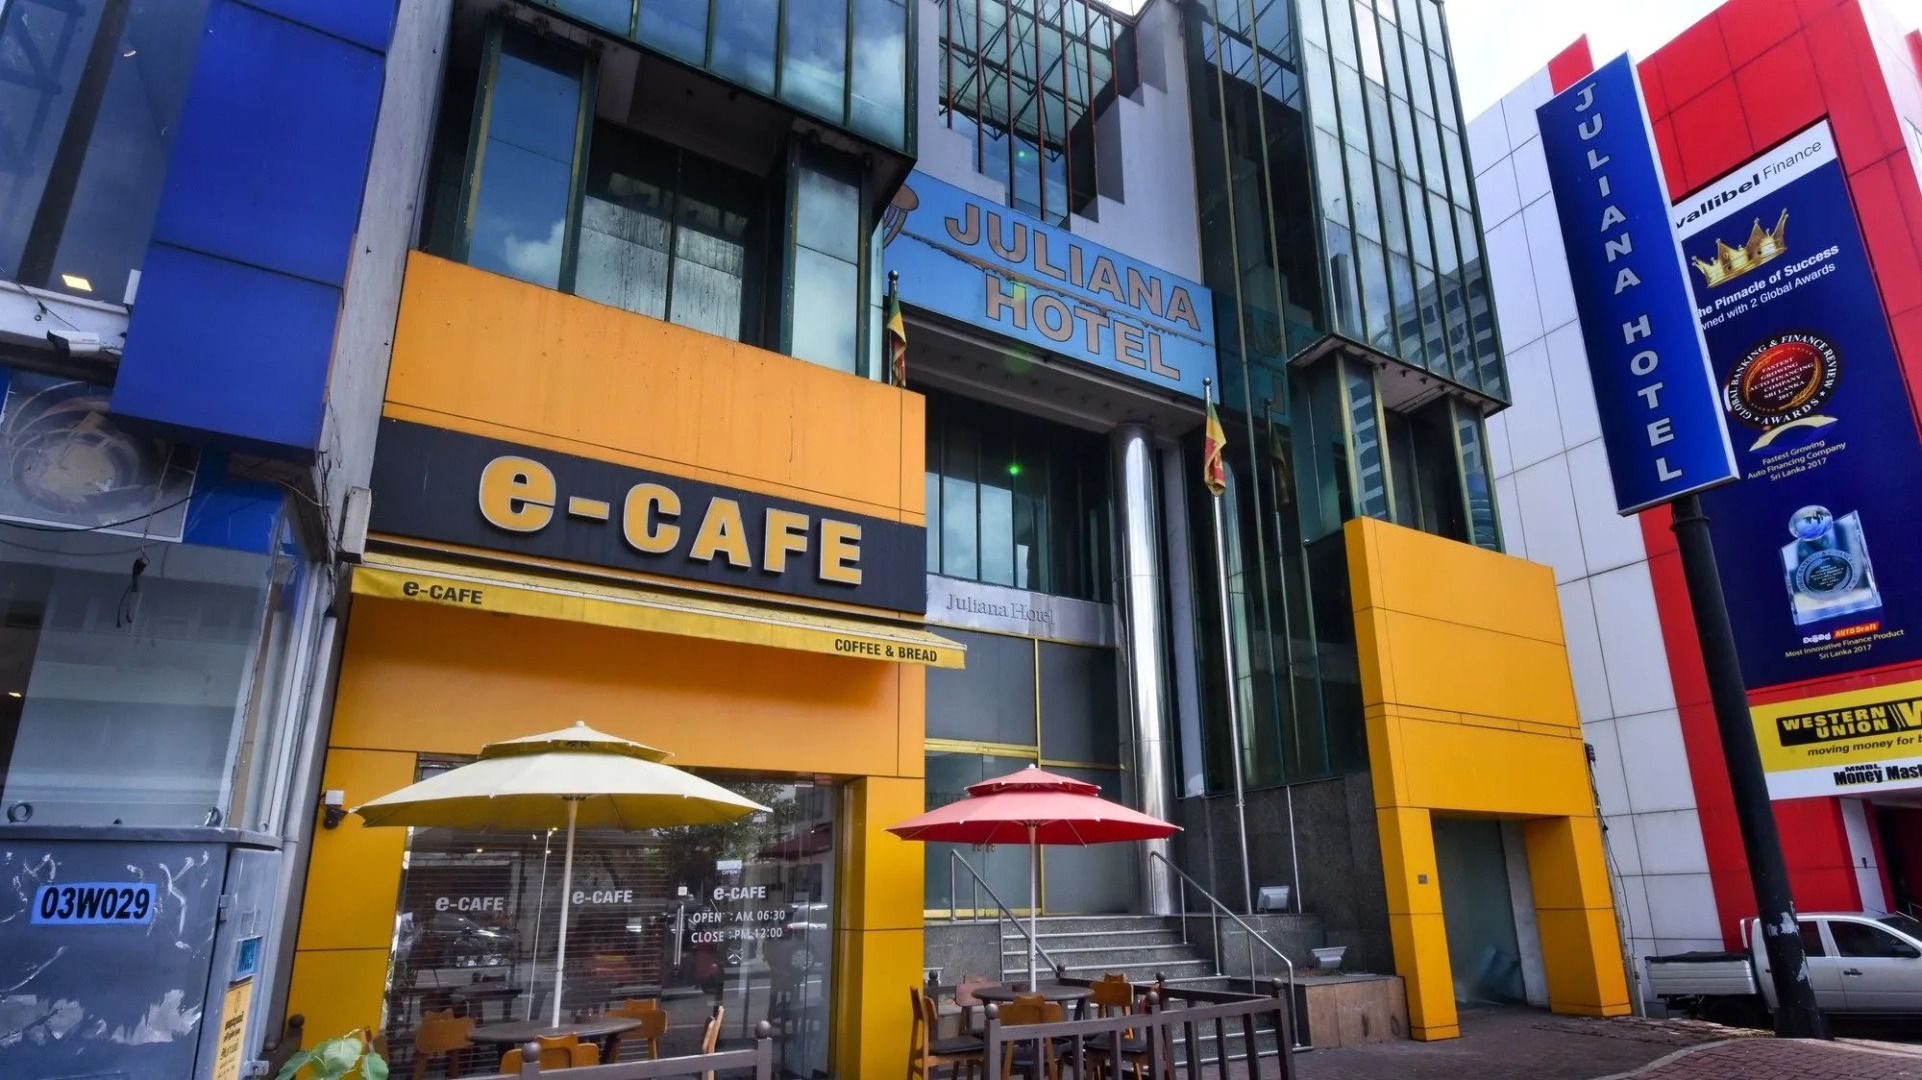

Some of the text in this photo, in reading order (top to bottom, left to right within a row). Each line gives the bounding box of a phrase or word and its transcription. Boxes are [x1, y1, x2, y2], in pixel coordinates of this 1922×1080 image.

[1675, 141, 1822, 228] vallibel Finance
[944, 202, 1201, 332] JULIANA
[1575, 82, 1683, 482] JULIANA HOTEL
[1699, 245, 1839, 318] he Pinnacle of Success
[1727, 303, 1748, 319] with
[1750, 298, 1758, 309] 2
[1760, 281, 1793, 304] Global
[1794, 263, 1836, 289] Awards
[986, 274, 1181, 381] HOTEL
[1729, 334, 1838, 420] GLOBAL BANKING & FINANCE REVIEW
[1750, 363, 1814, 391] AUTO FINANCING
[1760, 362, 1799, 380] GROWING
[1761, 357, 1794, 373] FASTEST
[1763, 375, 1801, 393] COMPANY
[1763, 380, 1805, 399] SRI LANKA
[1778, 391, 1794, 401] 2017
[1760, 398, 1820, 425] AWARDS
[1748, 442, 1846, 479] Auto Financing Company
[1762, 439, 1825, 465] Fastest Growing
[1770, 457, 1827, 481] Sri Lanka 2017
[478, 455, 863, 586] e-CAFE
[402, 580, 483, 605] e-CAFE
[946, 593, 1055, 625] Juliana Hotel
[1834, 627, 1855, 638] AUTO
[1856, 622, 1877, 634] Draft
[834, 638, 937, 663] COFFEE & BREAD
[1785, 648, 1803, 658] Most
[1804, 642, 1842, 654] Innovative
[1842, 636, 1872, 647] Finance
[1873, 629, 1904, 641] Product
[1819, 644, 1872, 661] Sri Lanka 2017
[1782, 705, 1887, 731] WESTERN
[1816, 718, 1889, 739] UNION
[1807, 743, 1850, 756] moving
[1852, 737, 1893, 752] money
[1896, 735, 1914, 746] for
[1833, 771, 1883, 786] Money
[1845, 763, 1881, 772] MMBL
[40, 887, 150, 919] 03W029
[435, 895, 504, 912] e-CAFE
[572, 888, 633, 905] e-CAFE
[713, 886, 766, 901] e-CAFE
[693, 912, 722, 923] OPEN
[757, 910, 785, 921] 06:30
[691, 931, 725, 943] CLOSE
[755, 927, 783, 939] 12:00
